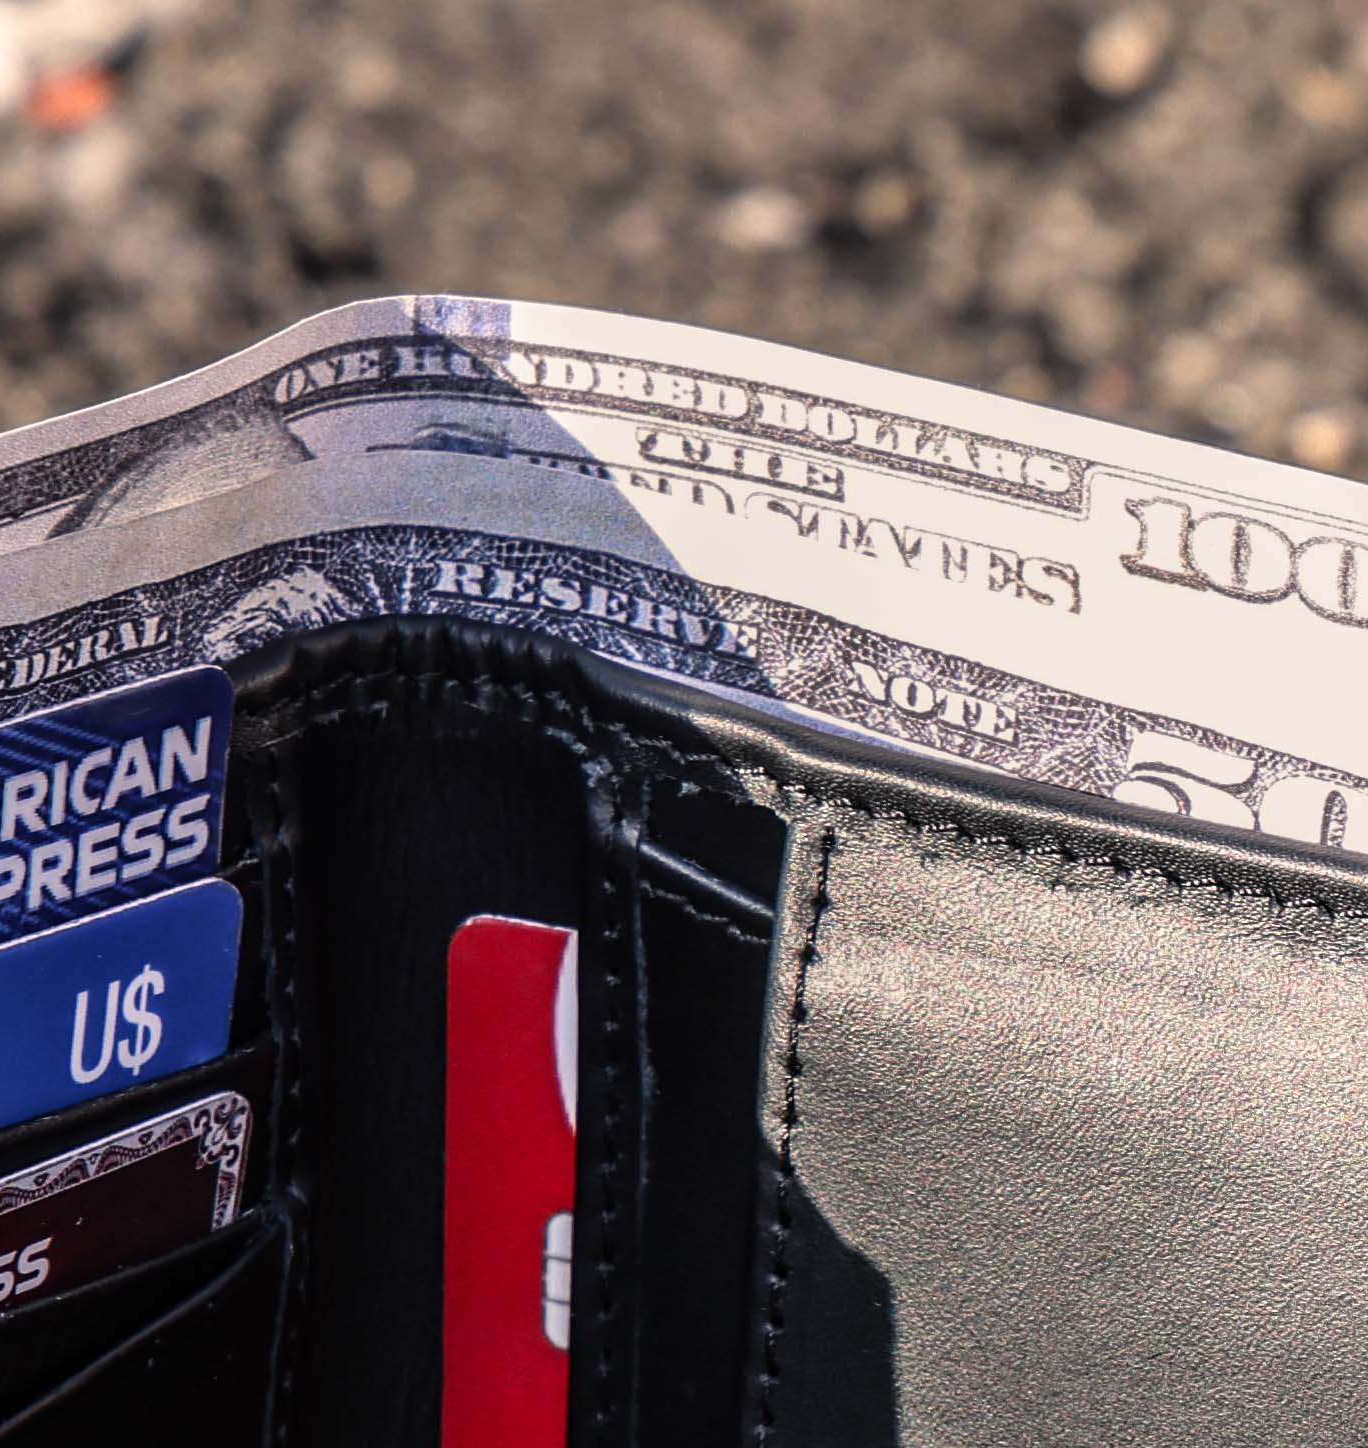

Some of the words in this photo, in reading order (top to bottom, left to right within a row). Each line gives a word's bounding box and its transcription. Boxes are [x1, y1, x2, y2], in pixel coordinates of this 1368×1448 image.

[275, 349, 382, 403] ONE
[390, 347, 748, 418] HUNDRED
[756, 394, 1073, 494] DOLLARS
[636, 426, 845, 503] THE
[434, 560, 761, 663] RESERVE
[849, 657, 1020, 746] NOTE
[69, 965, 165, 1085] U$
